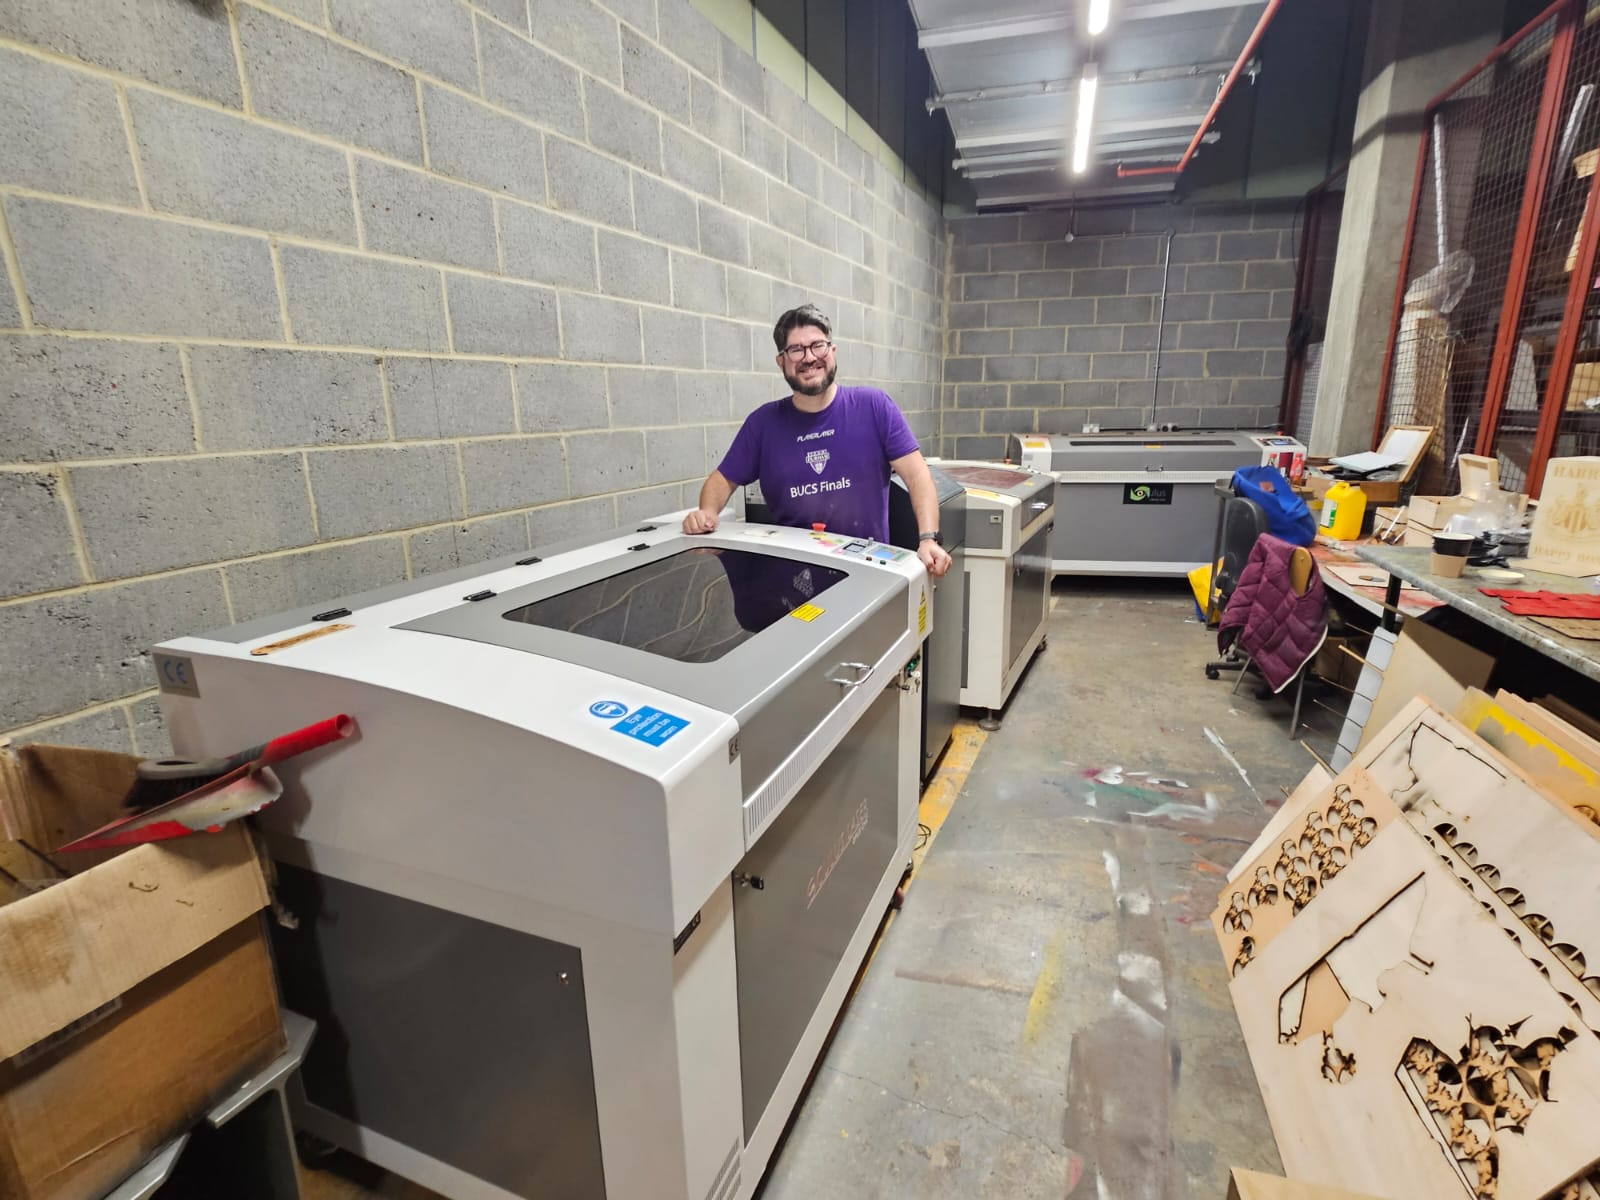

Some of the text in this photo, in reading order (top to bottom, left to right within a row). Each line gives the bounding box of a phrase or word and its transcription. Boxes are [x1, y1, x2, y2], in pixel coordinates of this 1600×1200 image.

[790, 476, 851, 498] BUCS Finals
[625, 713, 643, 724] Eye
[628, 712, 664, 735] protection
[642, 722, 662, 737] must
[658, 725, 678, 738] worn
